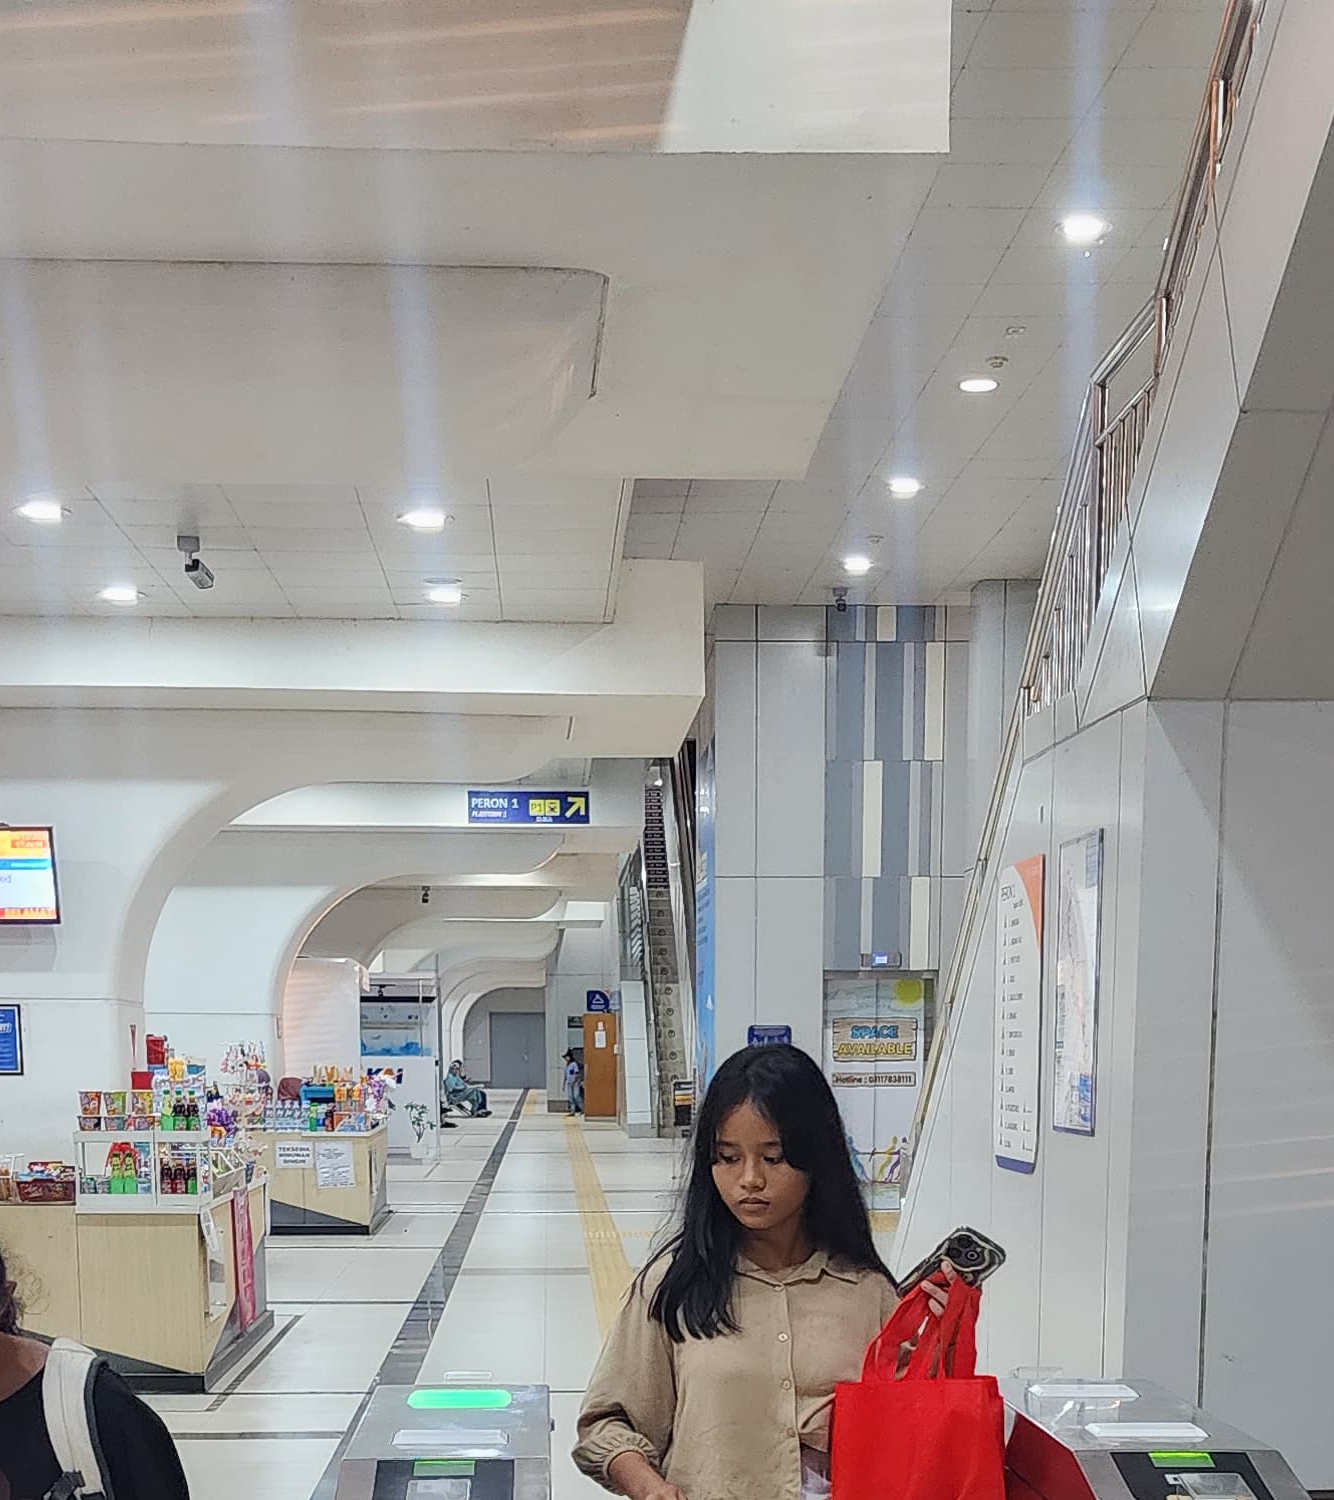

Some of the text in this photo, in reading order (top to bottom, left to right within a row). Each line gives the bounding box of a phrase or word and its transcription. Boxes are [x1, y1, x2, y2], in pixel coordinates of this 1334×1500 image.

[471, 798, 519, 809] PERON 1
[531, 803, 542, 812] P1
[851, 1025, 899, 1039] SPACE
[838, 1042, 913, 1056] AVAILABLE
[835, 1075, 862, 1084] Hotline
